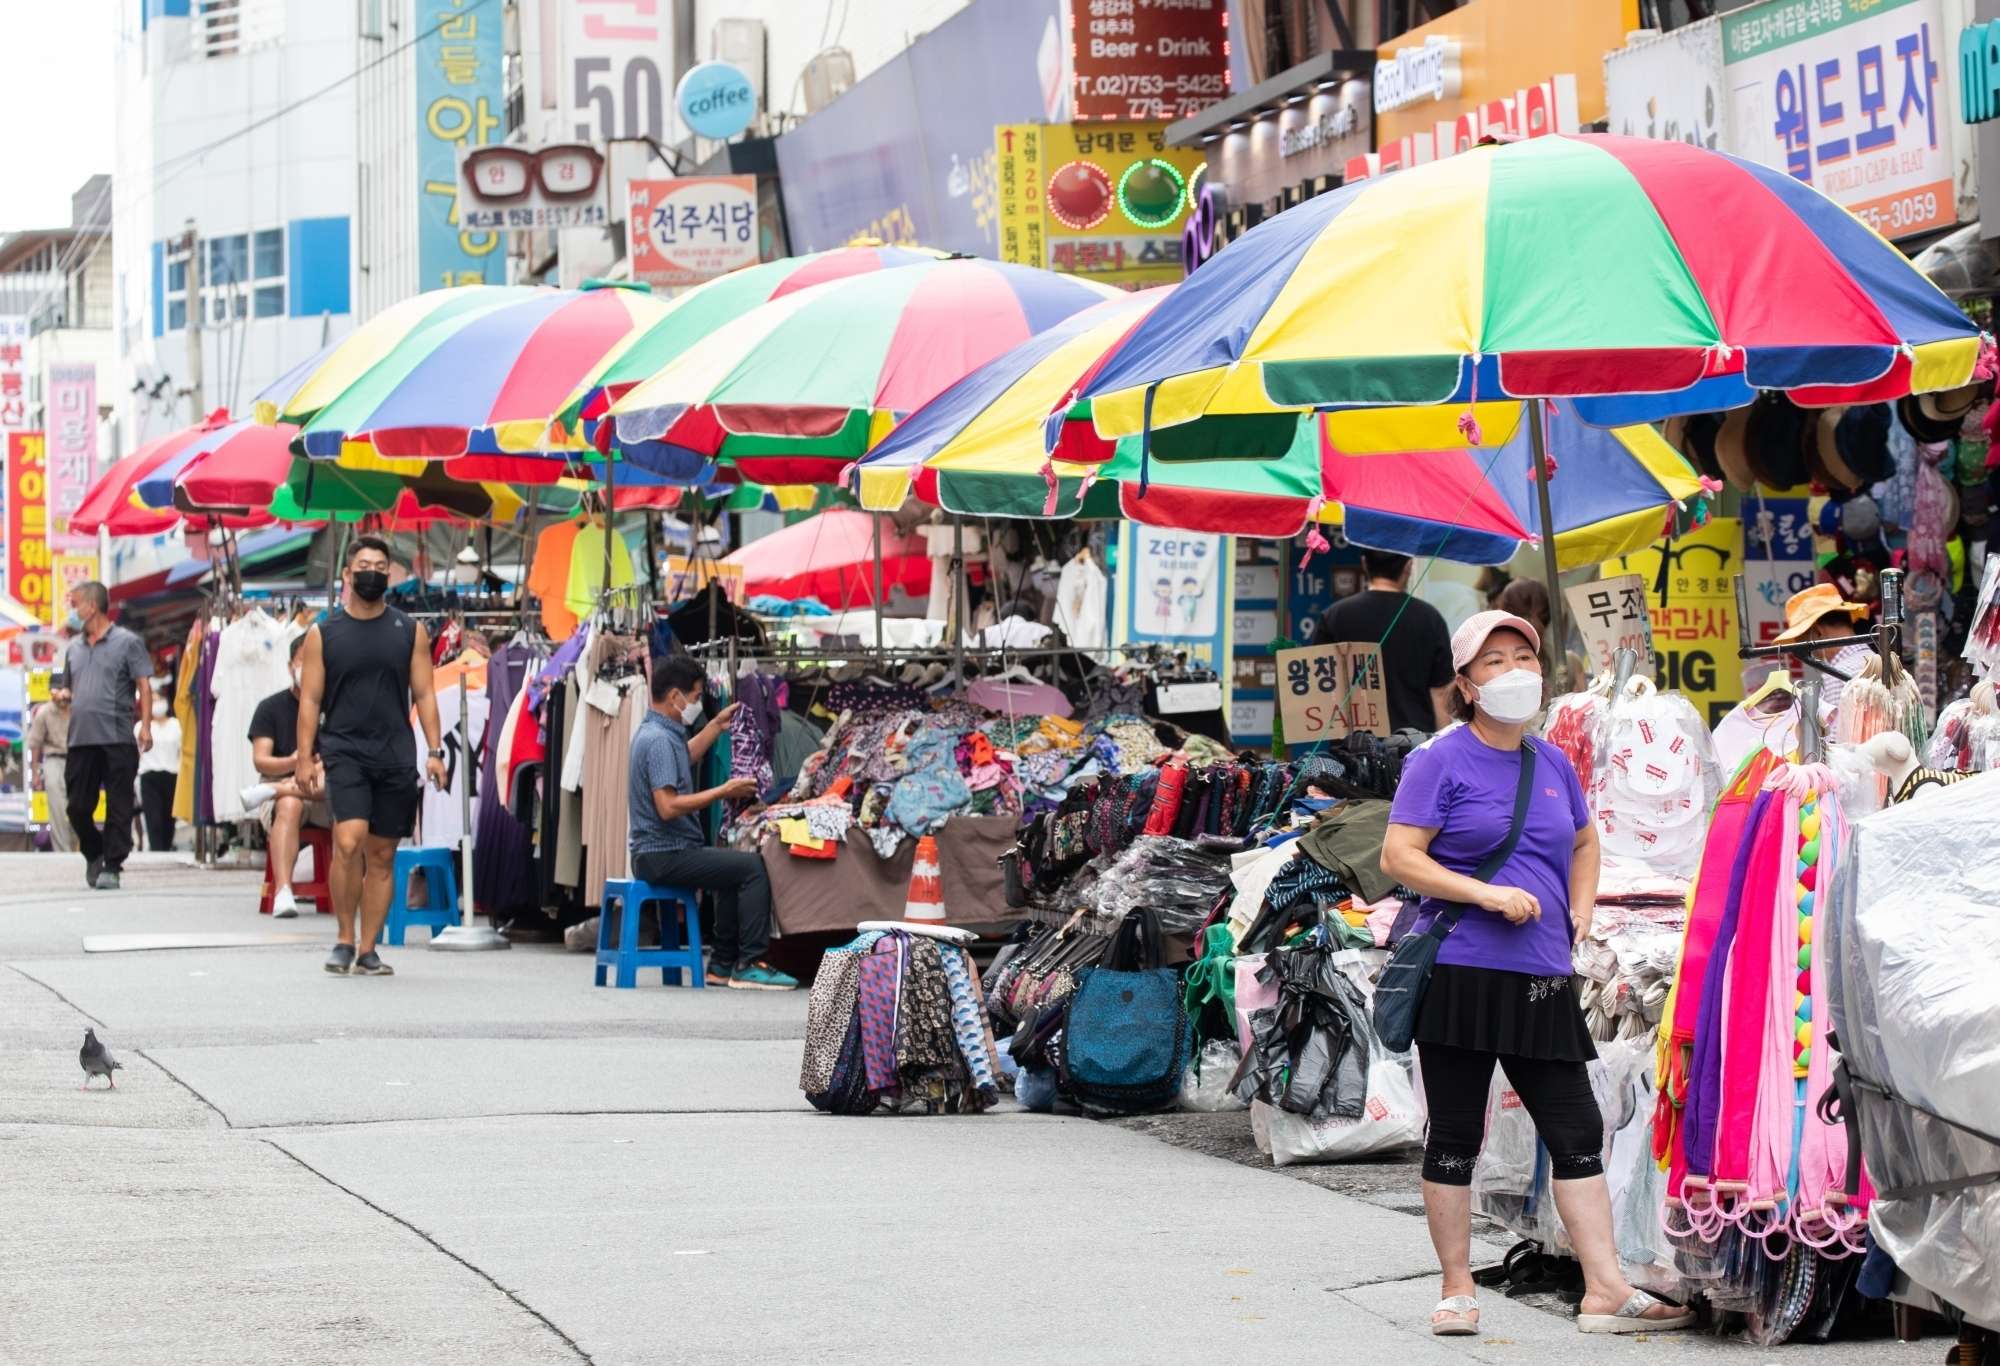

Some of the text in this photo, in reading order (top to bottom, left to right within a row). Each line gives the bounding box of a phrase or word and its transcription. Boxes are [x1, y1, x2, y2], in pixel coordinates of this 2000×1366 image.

[1090, 19, 1134, 35] 대추차
[1090, 37, 1212, 58] Beer Drink
[688, 85, 750, 117] coffee
[1079, 75, 1223, 96] T.02)753-5425
[574, 56, 662, 164] 50
[1775, 23, 1937, 187] 월드모자
[1075, 131, 1134, 154] 남대문
[488, 165, 505, 184] 안
[1823, 170, 1862, 194] WORLD
[1864, 163, 1891, 185] CAP
[1901, 150, 1926, 174] HAT
[1025, 168, 1039, 214] 20m
[654, 201, 754, 245] 전주식당
[1852, 192, 1938, 232] 55-3059
[0, 344, 23, 426] 부동산
[1149, 538, 1208, 557] zero
[1651, 607, 1730, 641] 객감사
[1287, 655, 1336, 696] 왕창
[1305, 703, 1379, 732] SALE
